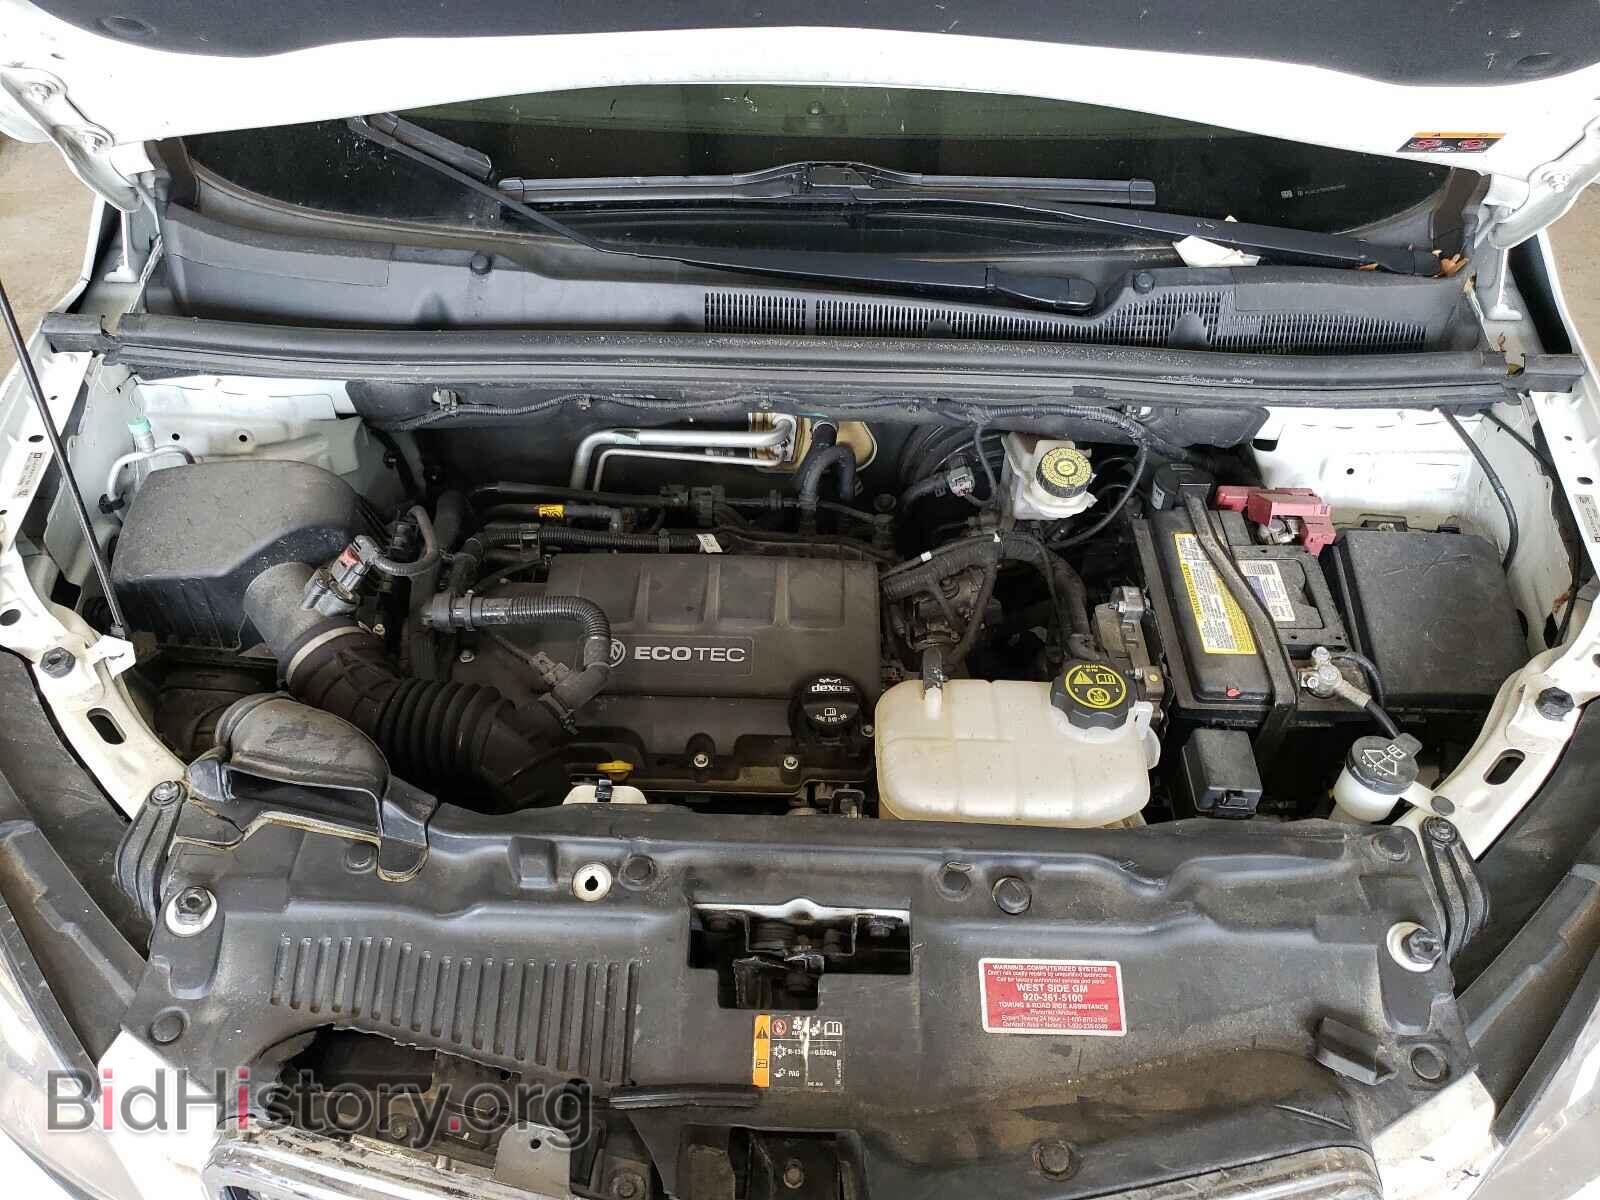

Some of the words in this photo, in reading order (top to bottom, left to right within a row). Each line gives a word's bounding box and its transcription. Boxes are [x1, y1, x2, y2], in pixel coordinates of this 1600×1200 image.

[634, 646, 745, 662] ECOTEC
[811, 683, 850, 692] dexos
[1016, 983, 1045, 992] WEST
[1048, 983, 1070, 993] SIDE
[1072, 984, 1088, 993] GM
